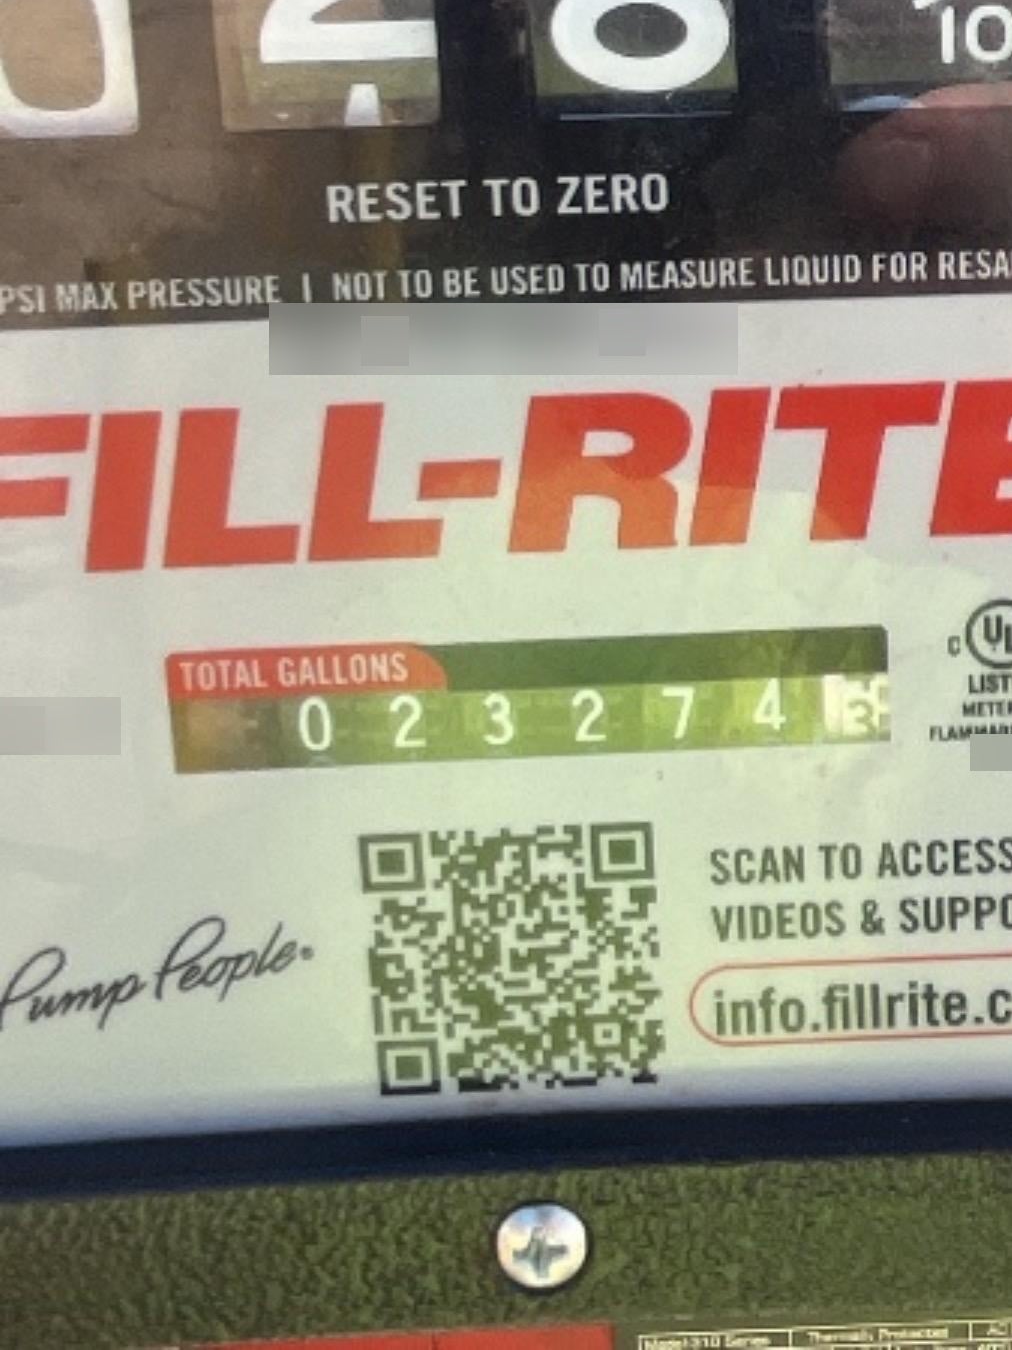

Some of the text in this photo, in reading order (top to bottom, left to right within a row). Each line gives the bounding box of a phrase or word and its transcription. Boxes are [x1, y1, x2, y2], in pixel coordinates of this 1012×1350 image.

[327, 172, 670, 223] RESET TO ZERO
[0, 283, 47, 316] PSI
[55, 280, 119, 313] MAX
[127, 274, 281, 310] PRESSURE
[332, 269, 388, 301] NOT
[399, 268, 433, 300] TO
[442, 266, 481, 299] BE
[491, 263, 565, 296] USED
[574, 262, 611, 293] TO
[620, 257, 756, 291] MEASURE
[764, 254, 862, 287] LIQUID
[872, 251, 928, 283] FOR
[178, 651, 409, 692] TOTAL GALLONS
[709, 846, 805, 886] SCAN
[818, 842, 863, 880] TO
[709, 900, 847, 942] VIDEOS
[860, 898, 886, 937] &
[0, 946, 148, 1032] Pump
